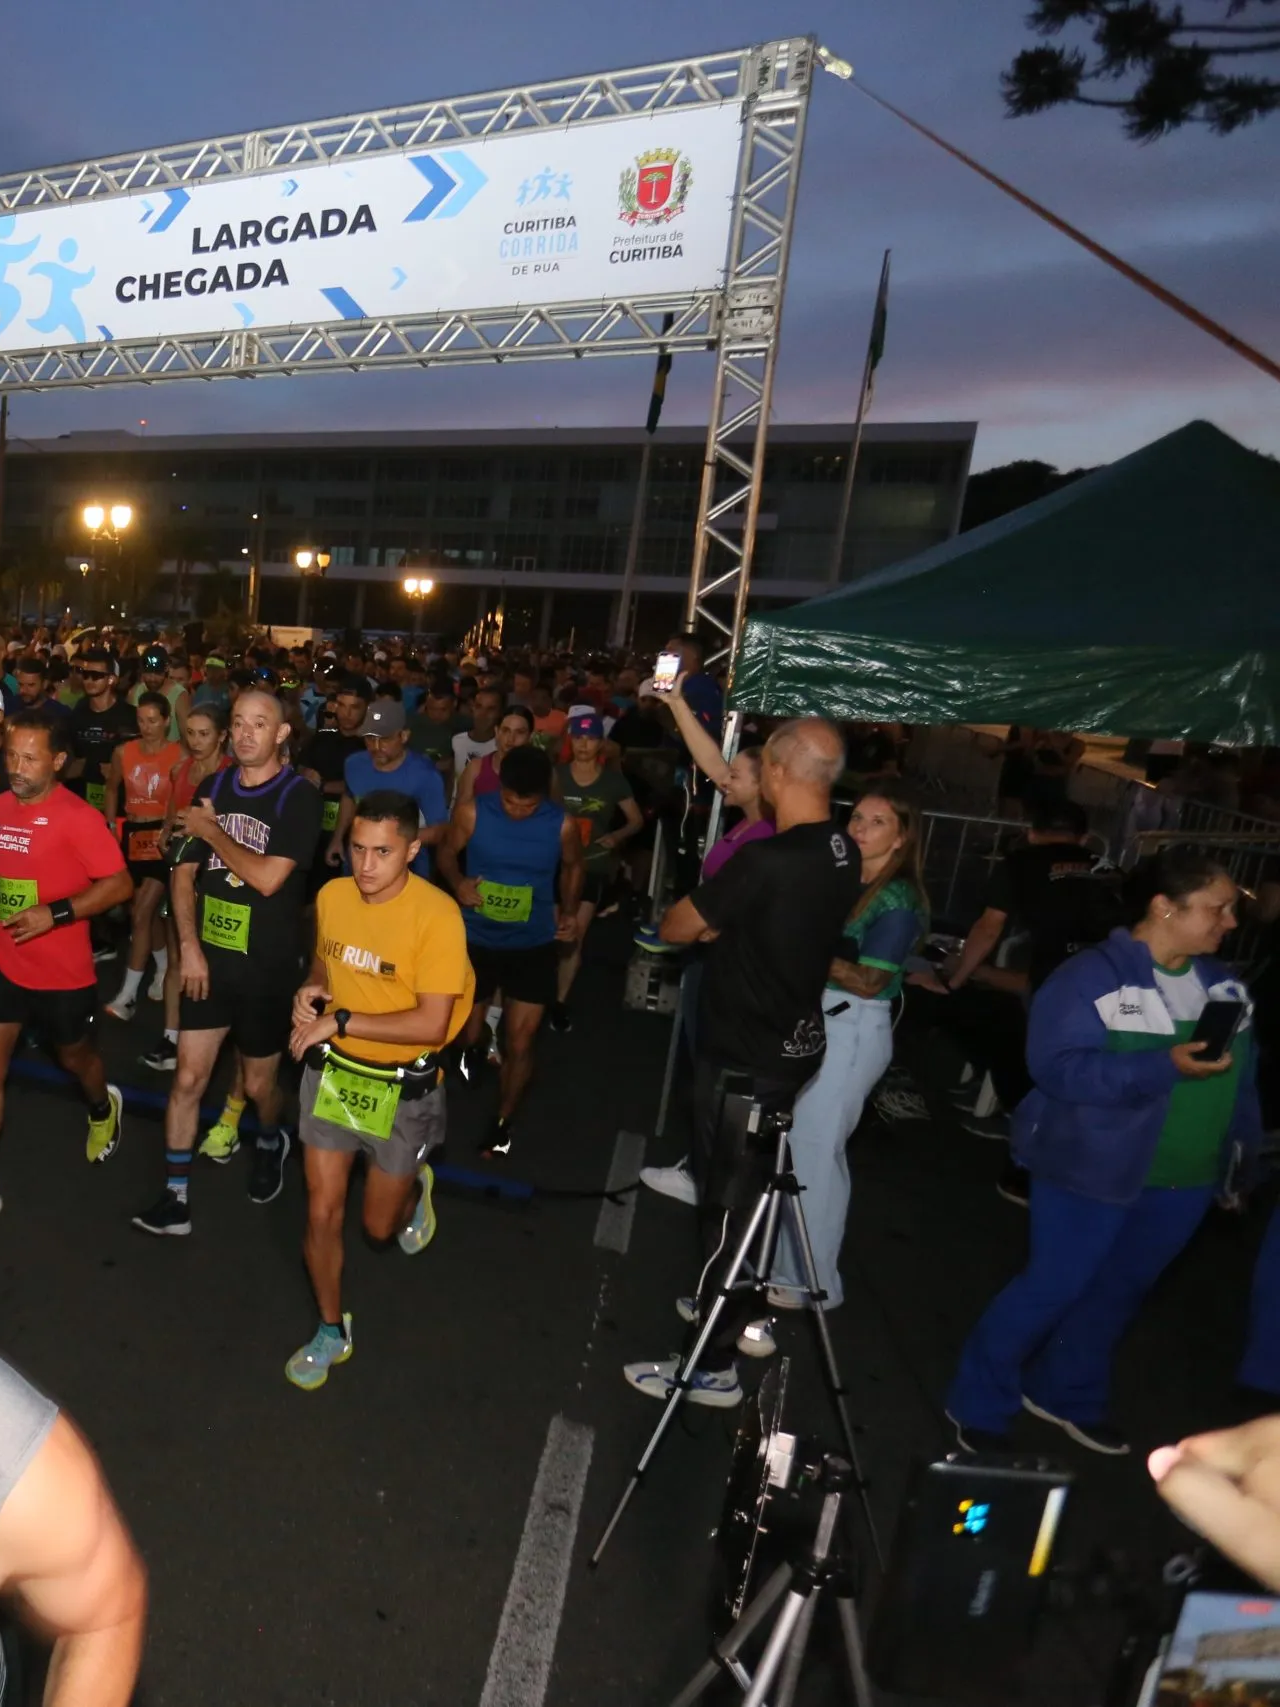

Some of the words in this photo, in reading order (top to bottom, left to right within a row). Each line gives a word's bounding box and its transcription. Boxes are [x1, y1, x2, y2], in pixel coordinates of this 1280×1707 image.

[191, 203, 378, 255] LARGADA
[503, 215, 577, 235] CURITIBA
[499, 231, 579, 259] CORRIDA
[612, 233, 667, 247] Prefeitura
[668, 229, 684, 242] de
[609, 244, 683, 264] CURITIBA
[511, 265, 528, 276] DE
[533, 262, 560, 274] RUA
[115, 258, 290, 303] CHEGADA
[486, 893, 521, 909] 5227
[208, 912, 242, 933] 4557
[342, 945, 380, 973] RUN
[338, 1087, 379, 1113] 5351
